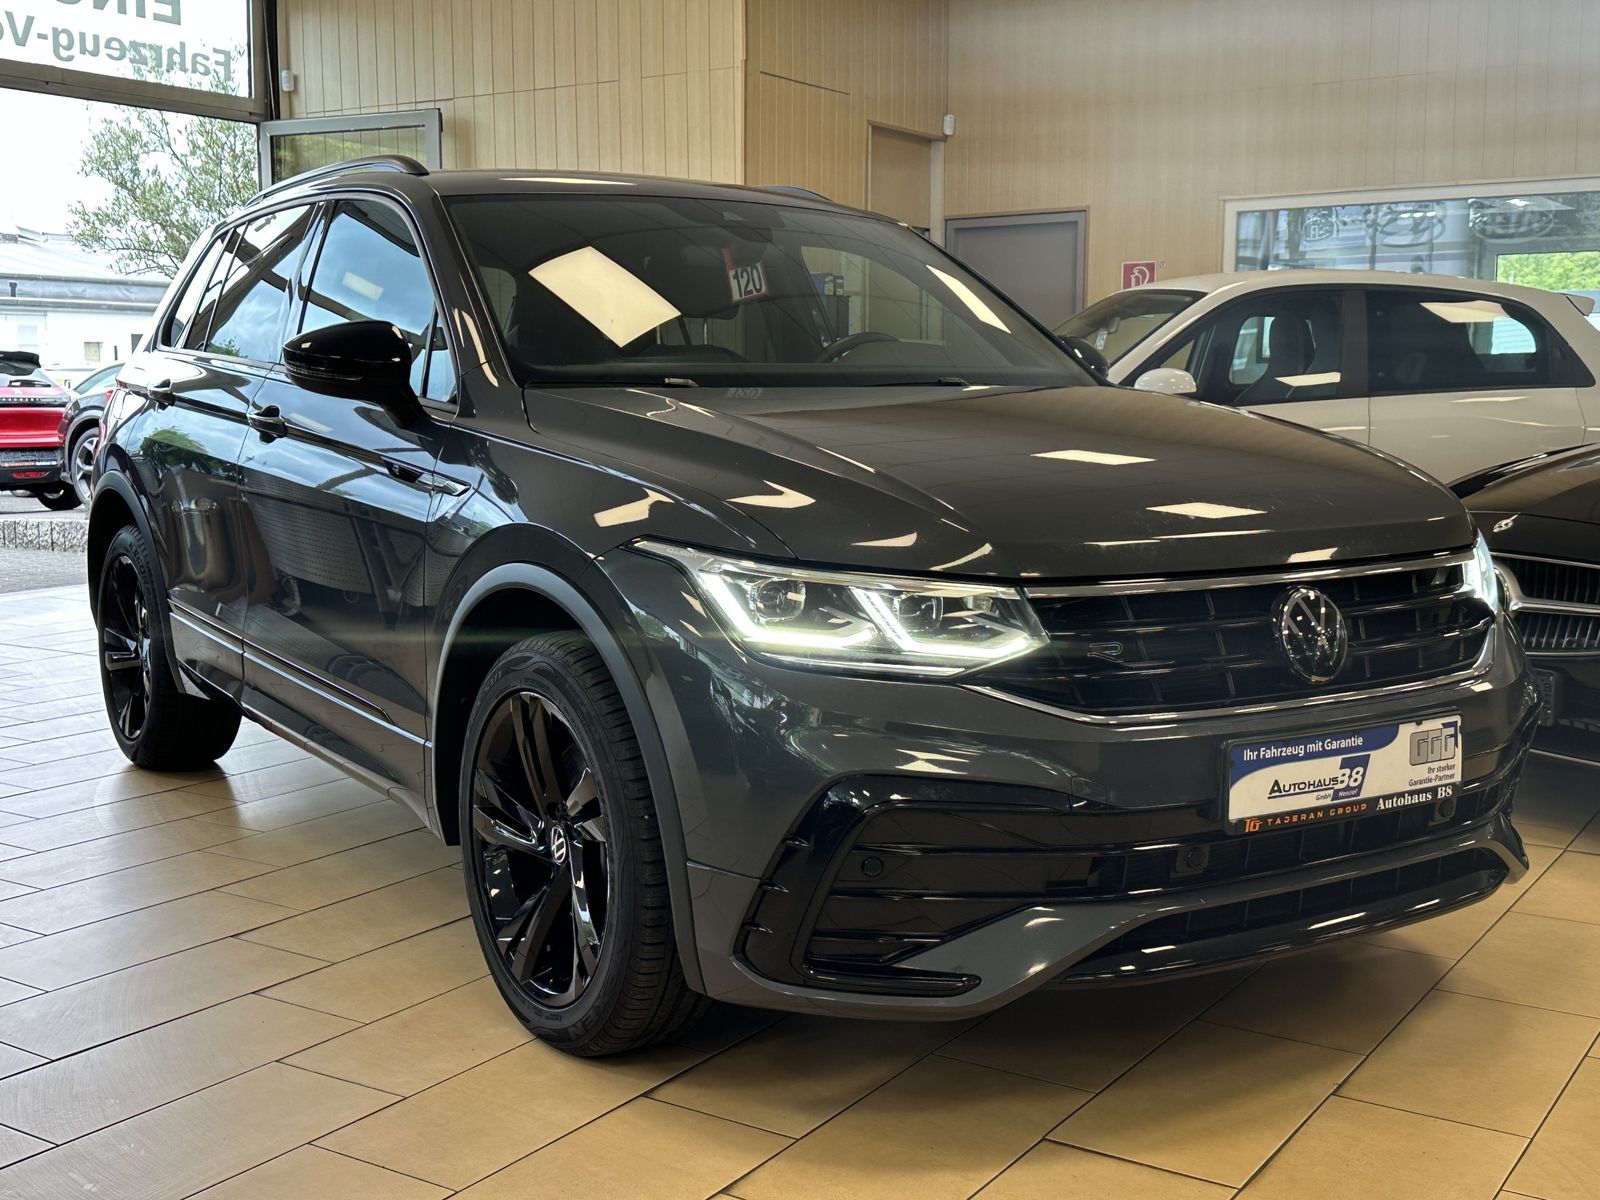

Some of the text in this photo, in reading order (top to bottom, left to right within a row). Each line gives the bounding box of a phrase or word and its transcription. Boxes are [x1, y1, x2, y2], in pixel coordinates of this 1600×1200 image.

[732, 263, 763, 298] 120
[1243, 735, 1363, 761] Ihr Fahrzeug mit Garantie
[1408, 773, 1456, 787] Garantie-Partner
[1329, 803, 1368, 816] GROUP
[1376, 785, 1453, 811] Autohaus B8
